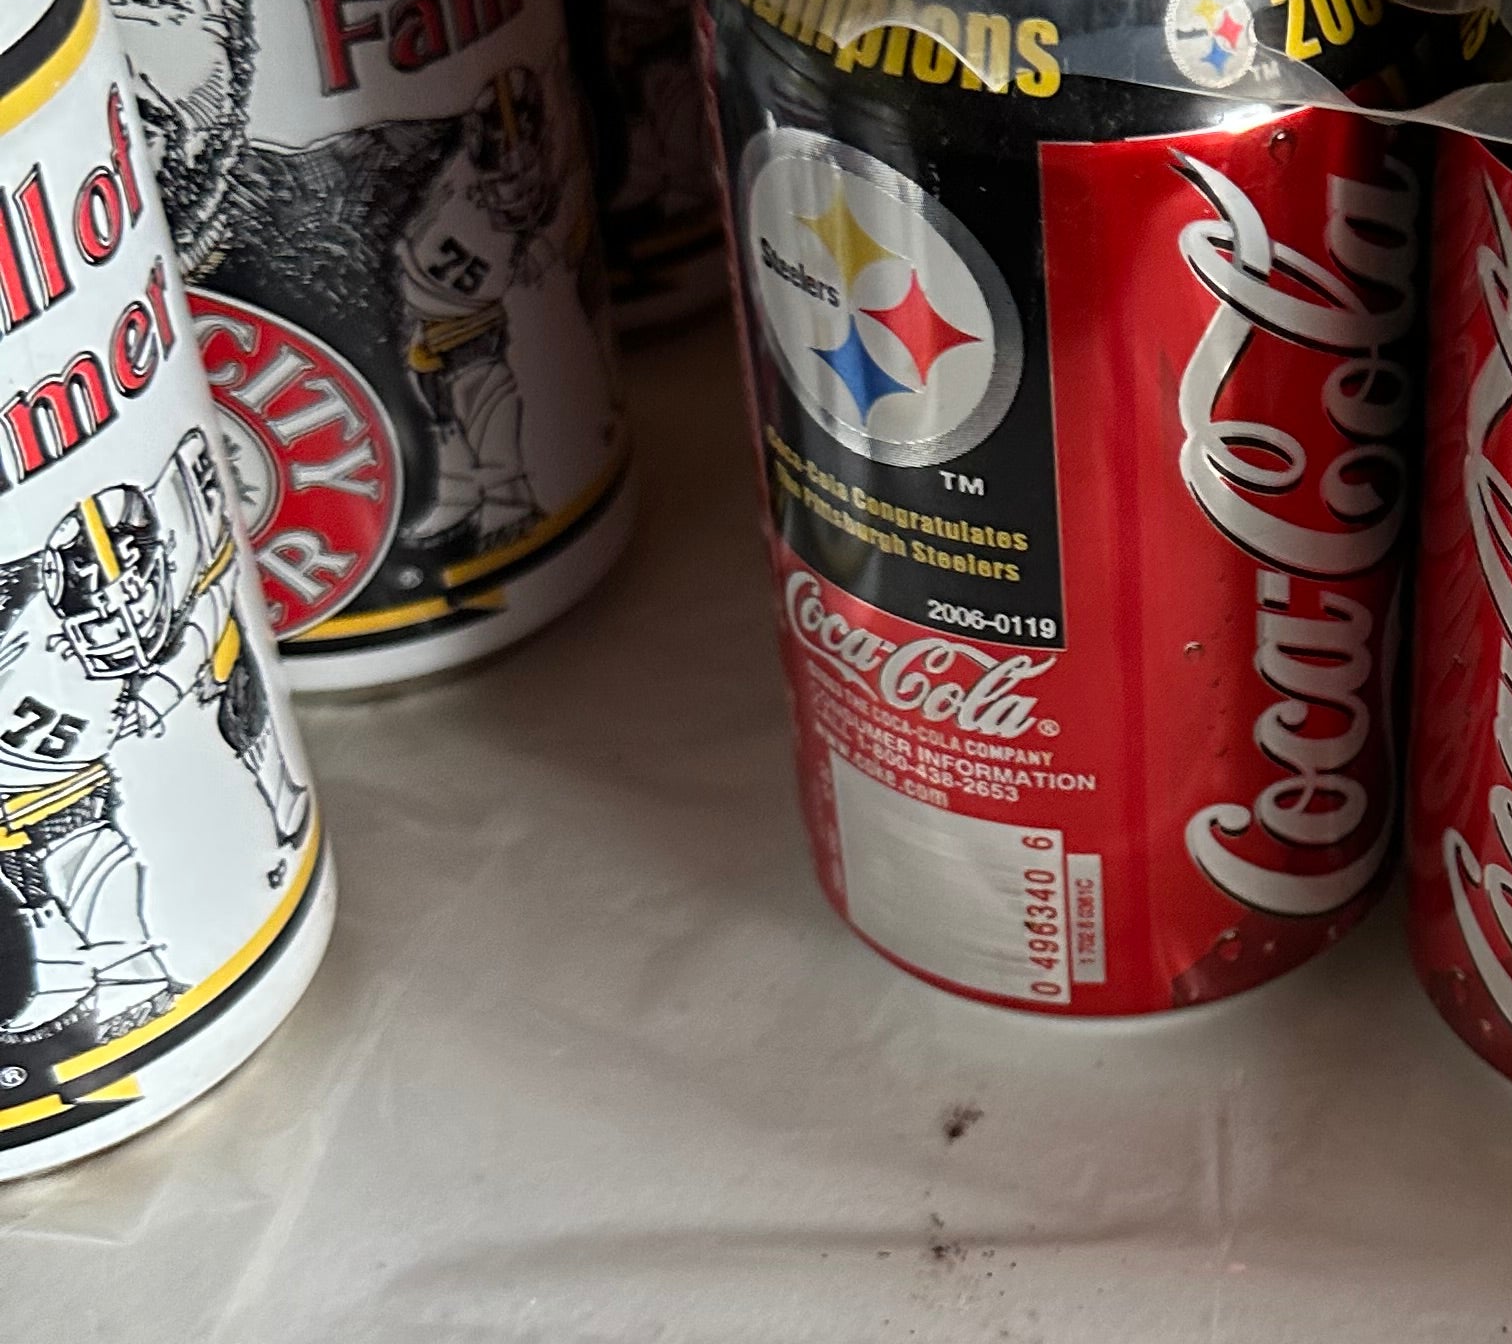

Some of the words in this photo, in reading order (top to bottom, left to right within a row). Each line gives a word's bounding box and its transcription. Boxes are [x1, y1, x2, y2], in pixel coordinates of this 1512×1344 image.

[74, 80, 144, 268] of
[938, 469, 986, 497] TM
[850, 485, 1029, 552] Congratulates
[1167, 147, 1424, 918] Coca-Cola
[911, 541, 1021, 584] Steelers
[927, 597, 1058, 641] 2006-0119
[785, 570, 1058, 740] Coca-Cola
[4, 695, 88, 757] 75
[963, 737, 1055, 767] COMPANY
[917, 745, 1096, 792] INFORMATION
